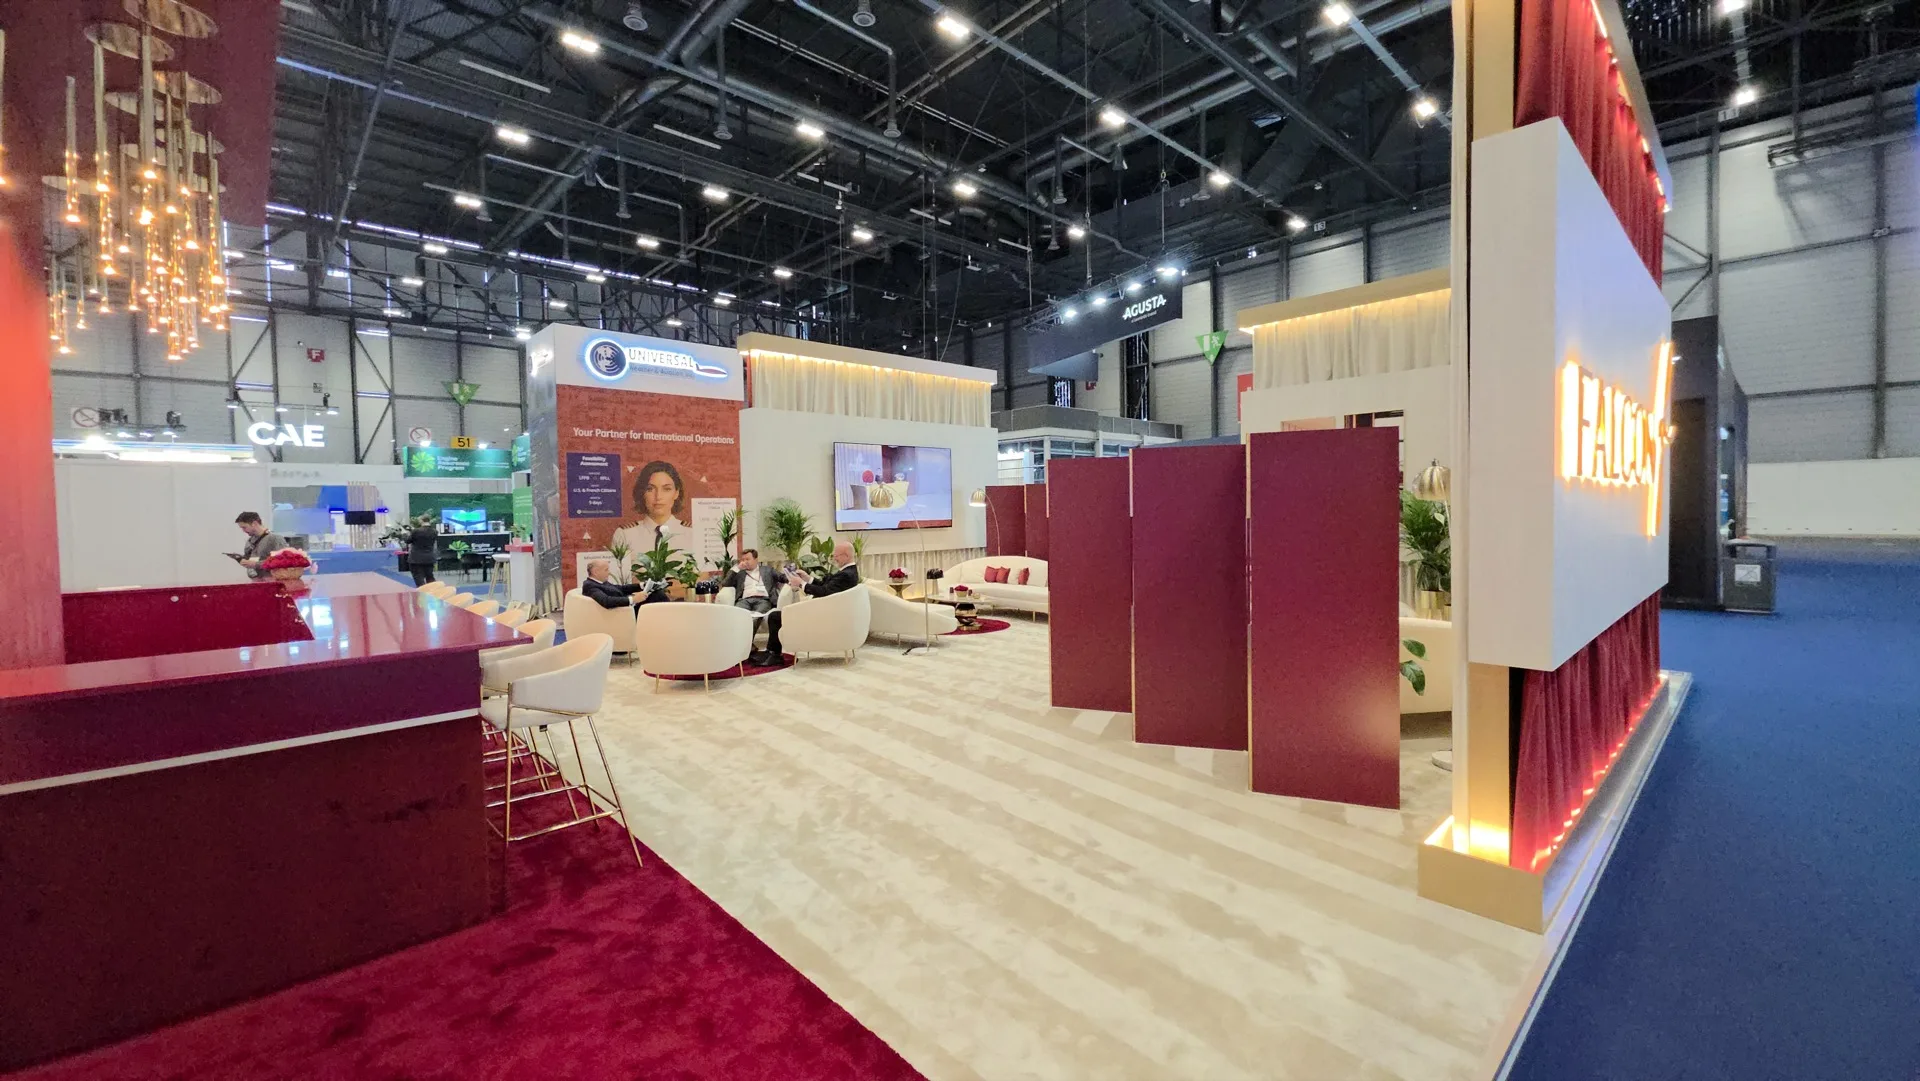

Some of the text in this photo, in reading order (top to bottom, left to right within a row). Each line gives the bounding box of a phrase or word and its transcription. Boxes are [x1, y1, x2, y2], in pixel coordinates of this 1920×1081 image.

[1122, 294, 1166, 320] AGUSTA
[628, 348, 694, 368] UNIVERSAL
[248, 422, 325, 447] CAE
[458, 437, 470, 448] 51
[573, 427, 734, 445] Your Partner for International Operations
